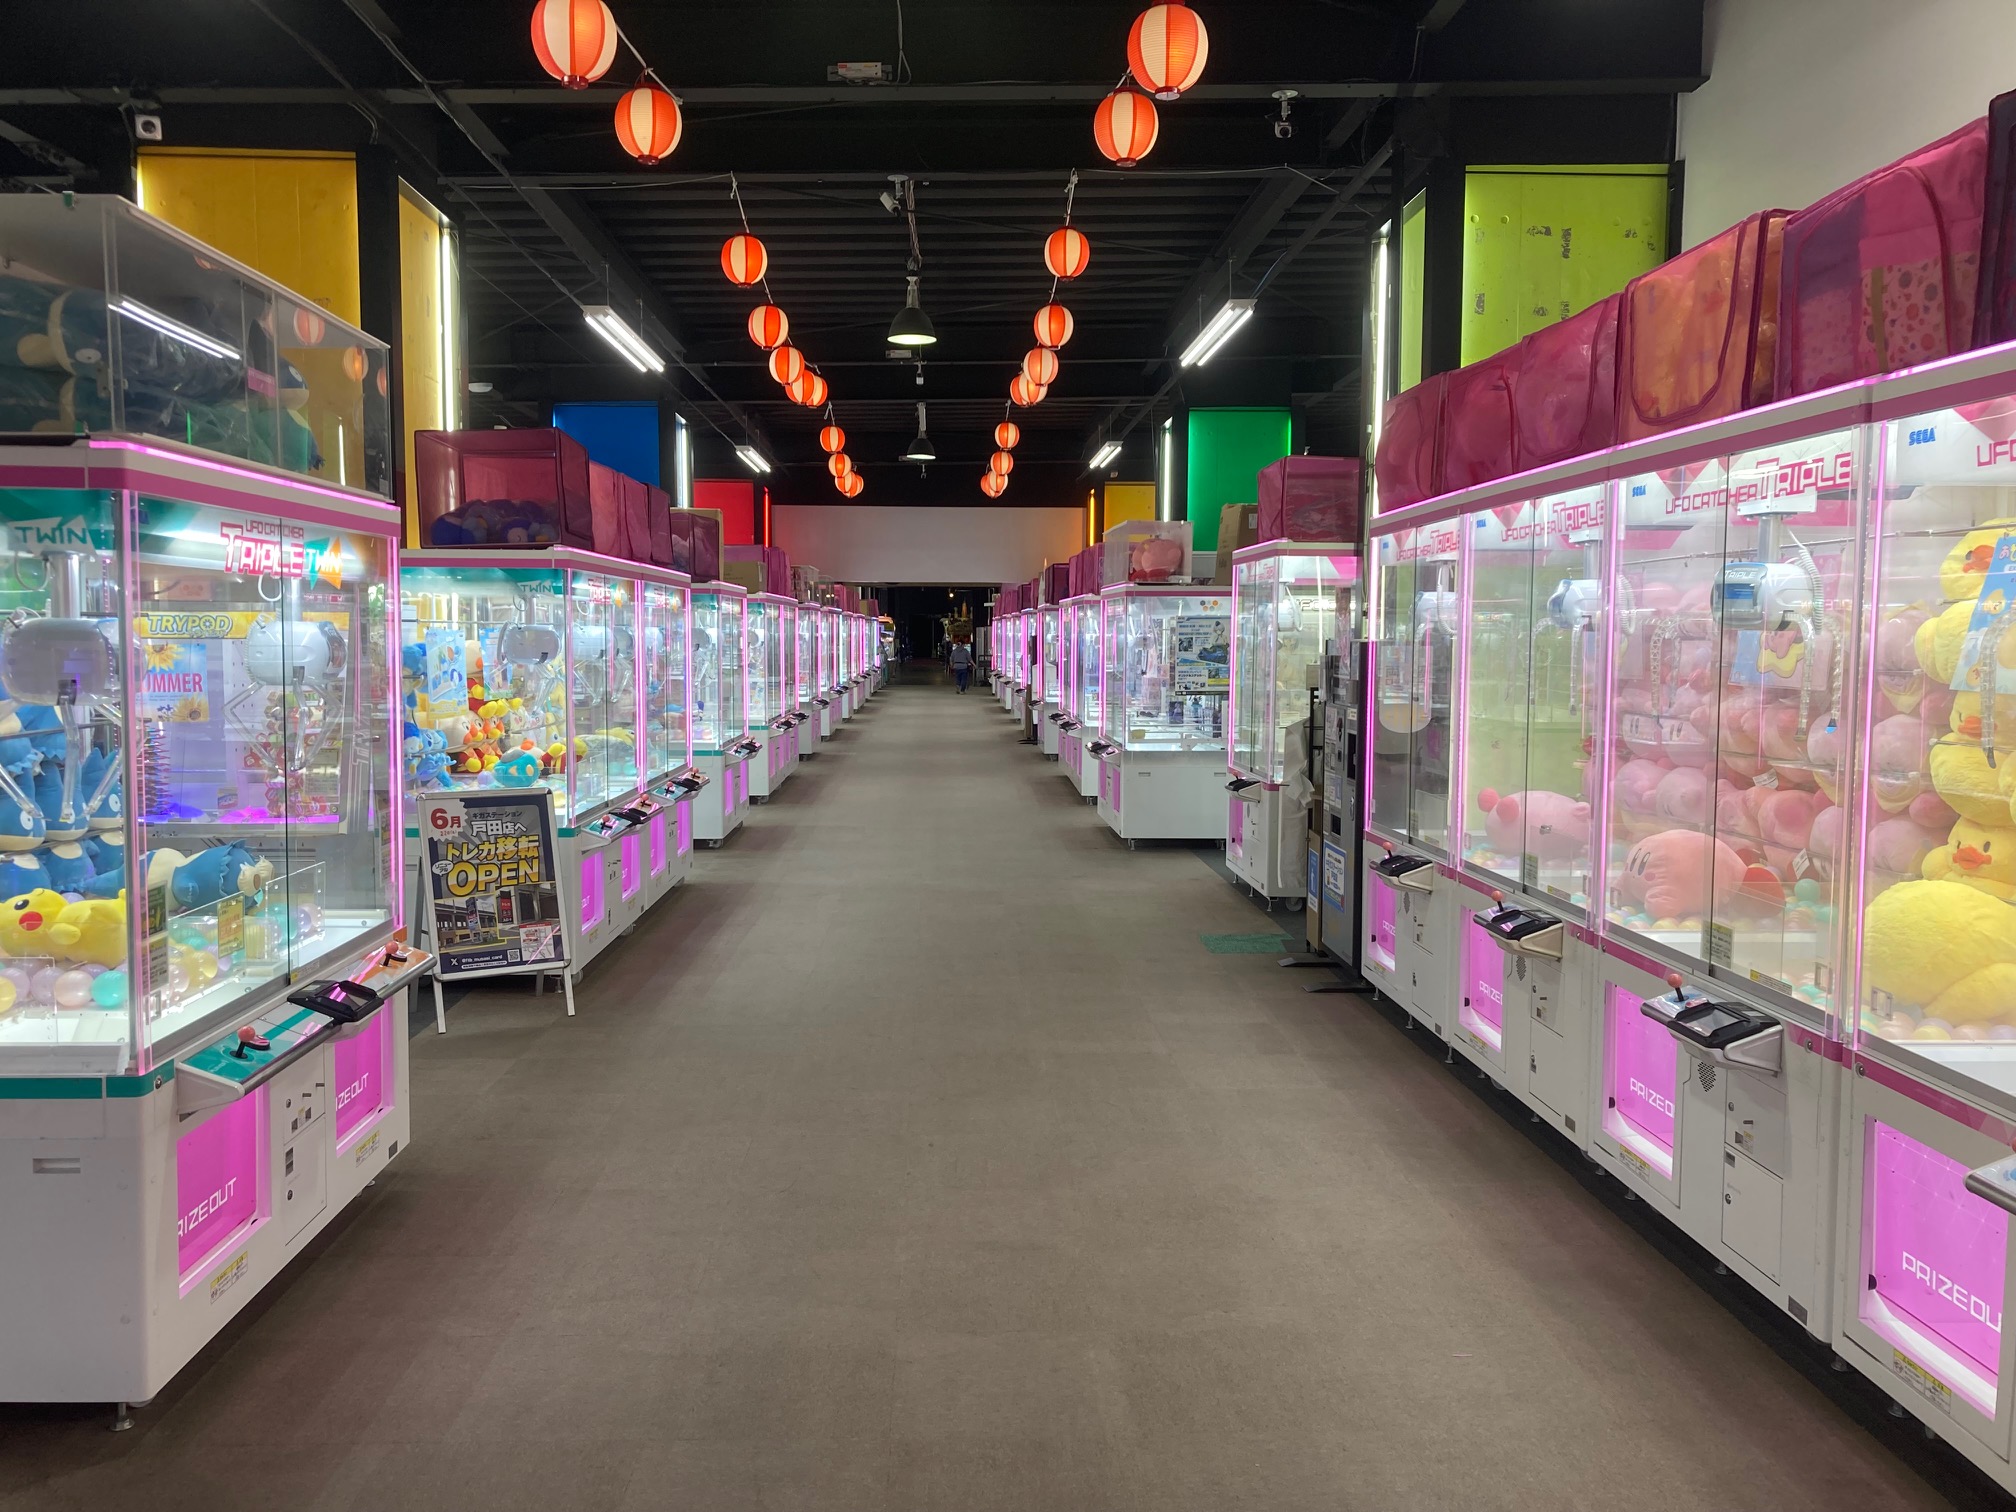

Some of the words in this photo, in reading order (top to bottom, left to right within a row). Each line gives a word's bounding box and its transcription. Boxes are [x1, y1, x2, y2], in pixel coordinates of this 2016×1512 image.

[1909, 427, 1936, 446] SEGA
[1755, 452, 1852, 500] TRIPLE
[1632, 484, 1647, 497] SEGA
[14, 526, 88, 545] TWIN
[220, 522, 304, 577] TRIPLE
[521, 584, 552, 593] TWIN
[147, 614, 232, 635] TRYPOD
[430, 808, 461, 830] 6月
[471, 820, 527, 837] 戸田店へ
[447, 834, 540, 861] トレカ移転
[447, 859, 540, 897] OPEN
[1630, 1077, 1675, 1119] PRIZEO
